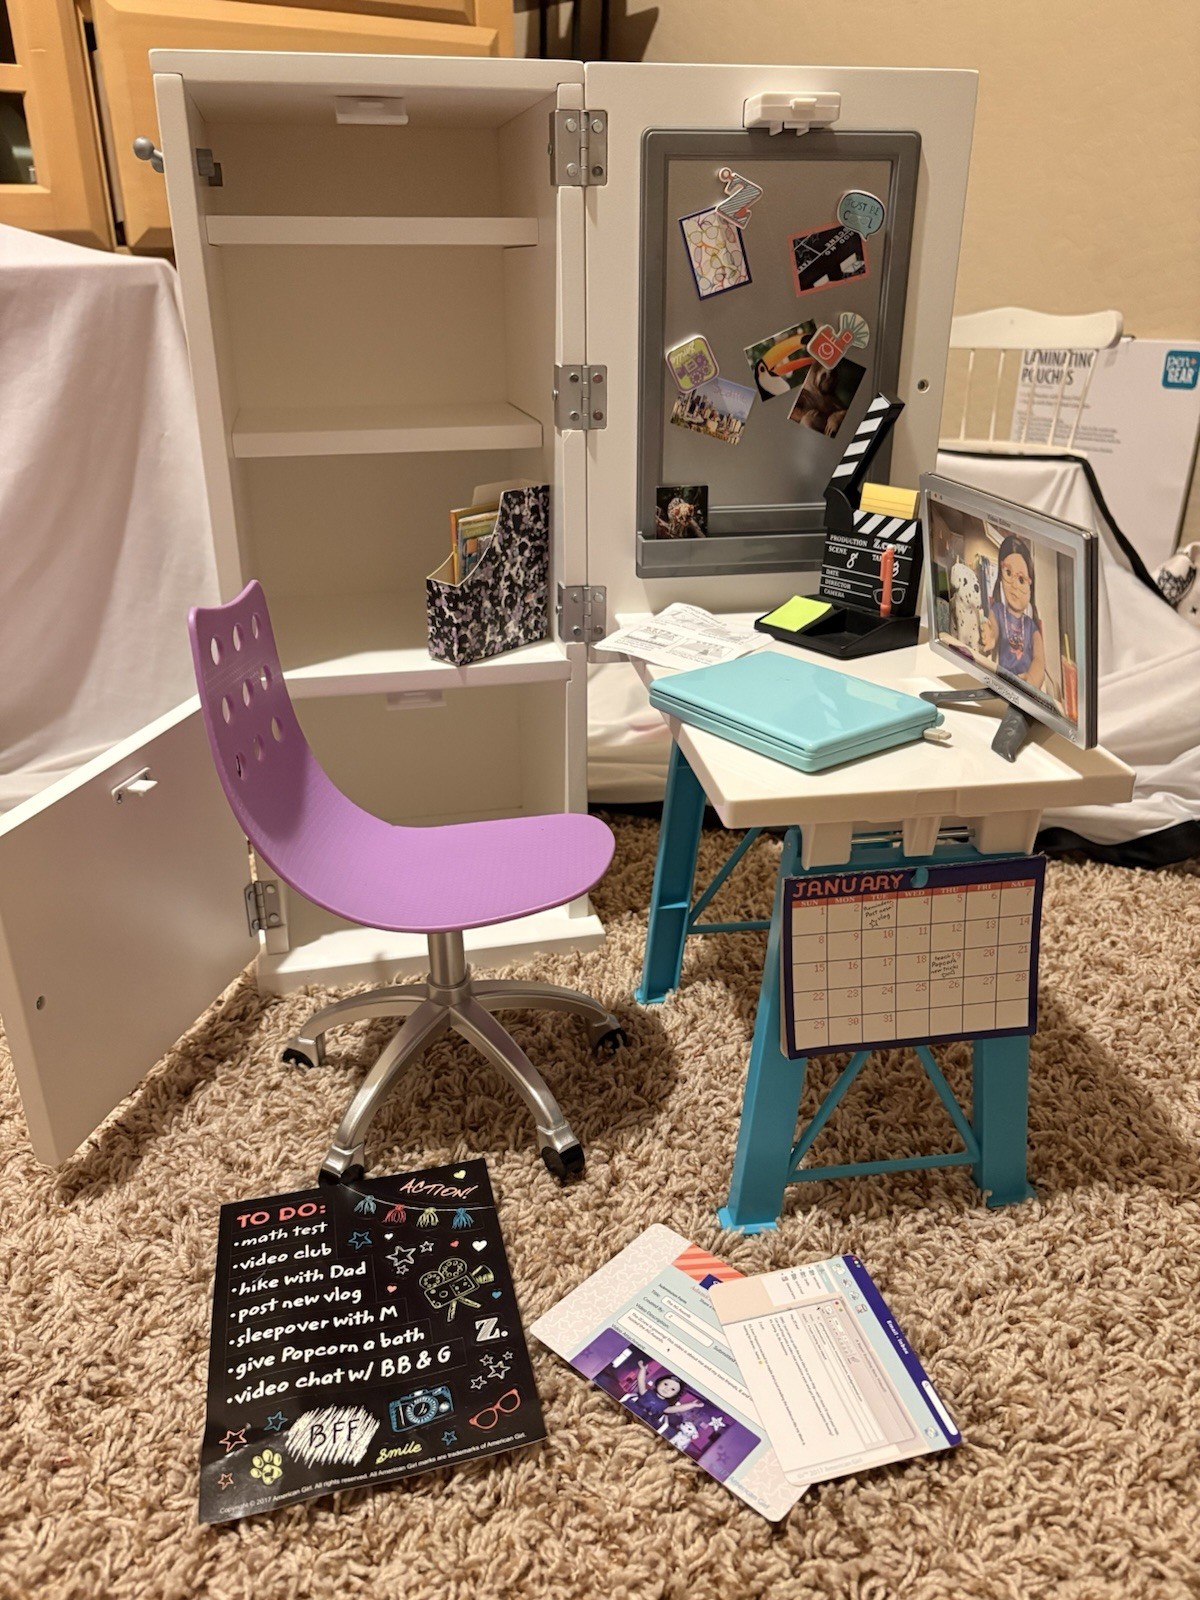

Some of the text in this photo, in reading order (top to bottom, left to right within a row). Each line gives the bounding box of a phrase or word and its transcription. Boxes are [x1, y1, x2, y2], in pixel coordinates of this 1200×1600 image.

[828, 545, 848, 555] SCENE
[830, 534, 868, 547] PRODUCTION
[824, 579, 851, 590] DIRECTOR
[825, 568, 840, 577] DATE
[823, 588, 845, 598] CAMERA
[792, 873, 904, 898] JANUARY
[820, 906, 825, 916] 1
[853, 903, 859, 912] 2
[923, 898, 929, 906] 4
[957, 894, 962, 902] 5
[1025, 888, 1032, 897] 7
[835, 896, 856, 904] MON
[818, 917, 1030, 944] 8 9 10 11 12 13 14
[814, 945, 1028, 973] 15 16 17 18 19 20 21
[812, 973, 1027, 1001] 22 23 24 25 26 27 28
[813, 1014, 893, 1029] 29 30 31
[400, 1178, 479, 1200] ACTION!
[236, 1202, 327, 1229] TO DO:
[241, 1221, 328, 1247] math test
[240, 1242, 332, 1270] video club
[238, 1260, 367, 1296] hike with Dad
[237, 1285, 362, 1323] post new vlog
[635, 1302, 669, 1329] Video Description:
[236, 1305, 399, 1348] sleepover with M
[610, 1323, 623, 1333] Video
[642, 1296, 659, 1309] Created
[713, 1345, 736, 1363] Submitted
[886, 1319, 899, 1336] Email
[234, 1327, 425, 1380] give Popcorn a bath
[234, 1346, 452, 1405] video chat w/ BB & G
[309, 1418, 361, 1448] BFF
[219, 1502, 250, 1514] Copyright
[256, 1497, 273, 1507] 2017
[272, 1489, 301, 1502] American
[301, 1484, 314, 1494] Girl.
[323, 1478, 340, 1488] rights
[340, 1474, 368, 1484] reserved.
[369, 1471, 378, 1479] All
[378, 1465, 406, 1477] American
[406, 1461, 418, 1470] Girl
[418, 1457, 436, 1467] marks
[447, 1446, 480, 1459] trademarks
[480, 1443, 488, 1451] of
[487, 1436, 515, 1448] American
[514, 1431, 527, 1440] Girl.
